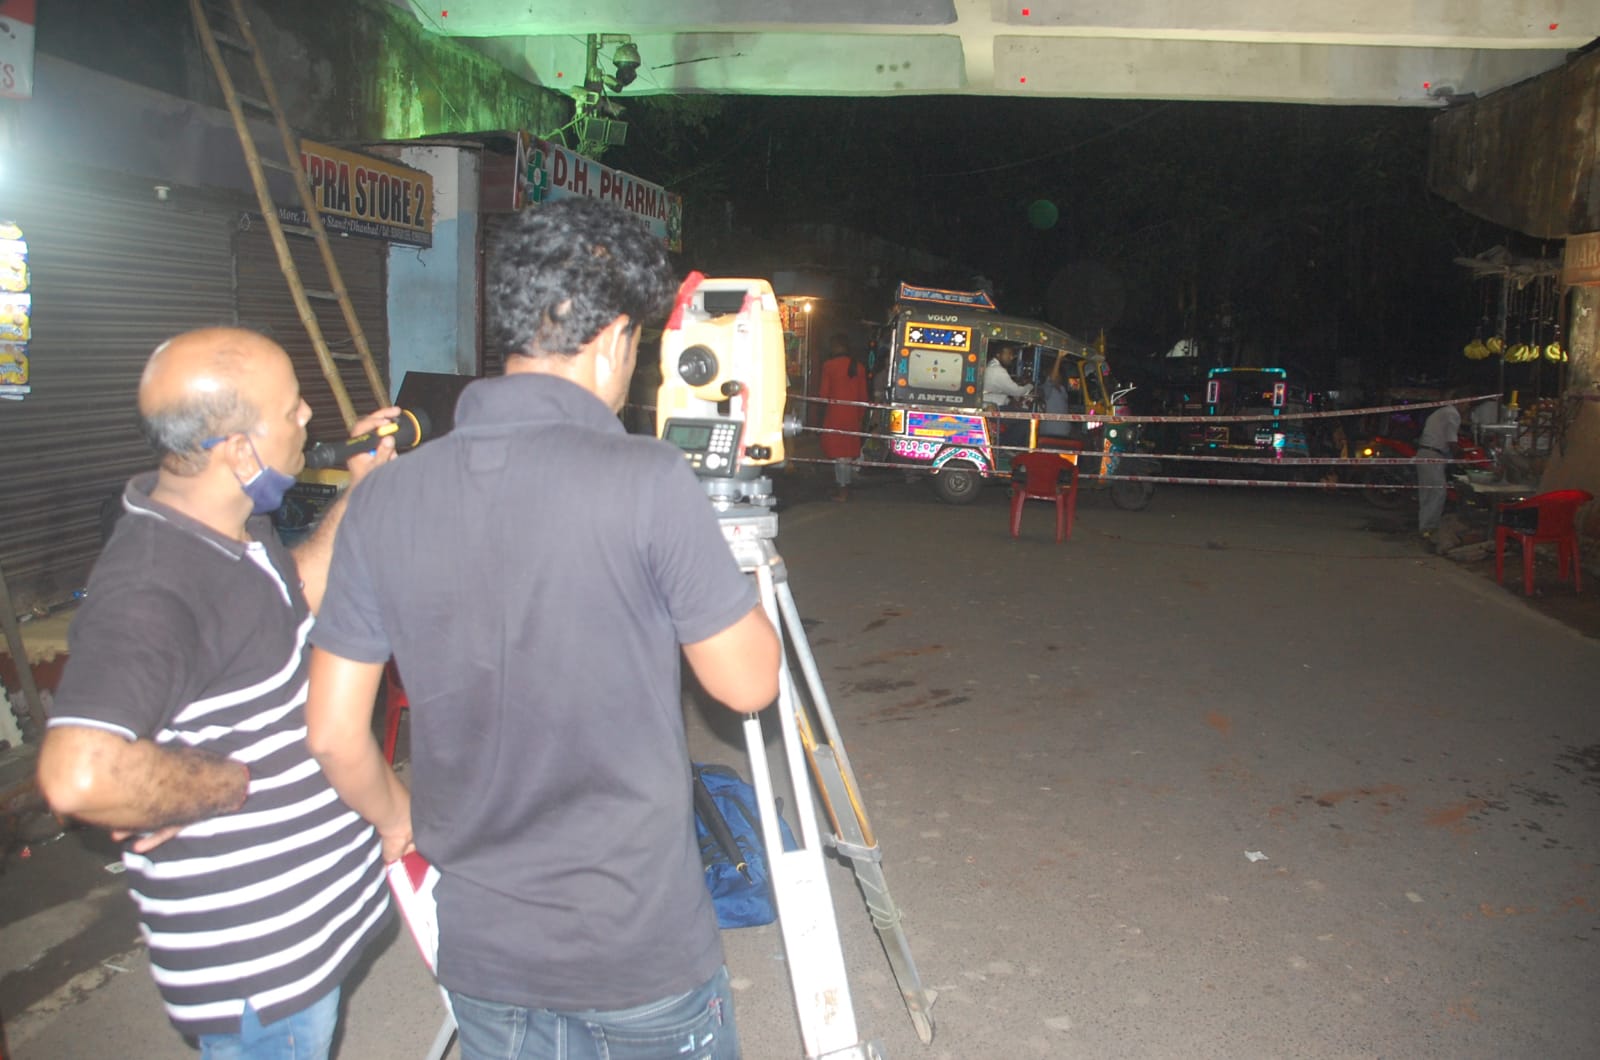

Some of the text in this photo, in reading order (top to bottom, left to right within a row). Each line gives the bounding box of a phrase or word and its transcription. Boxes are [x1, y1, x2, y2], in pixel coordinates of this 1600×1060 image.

[355, 167, 411, 225] STORE
[414, 183, 425, 227] 2
[553, 149, 666, 221] D.H. PHARMA
[927, 314, 958, 323] VOLVO
